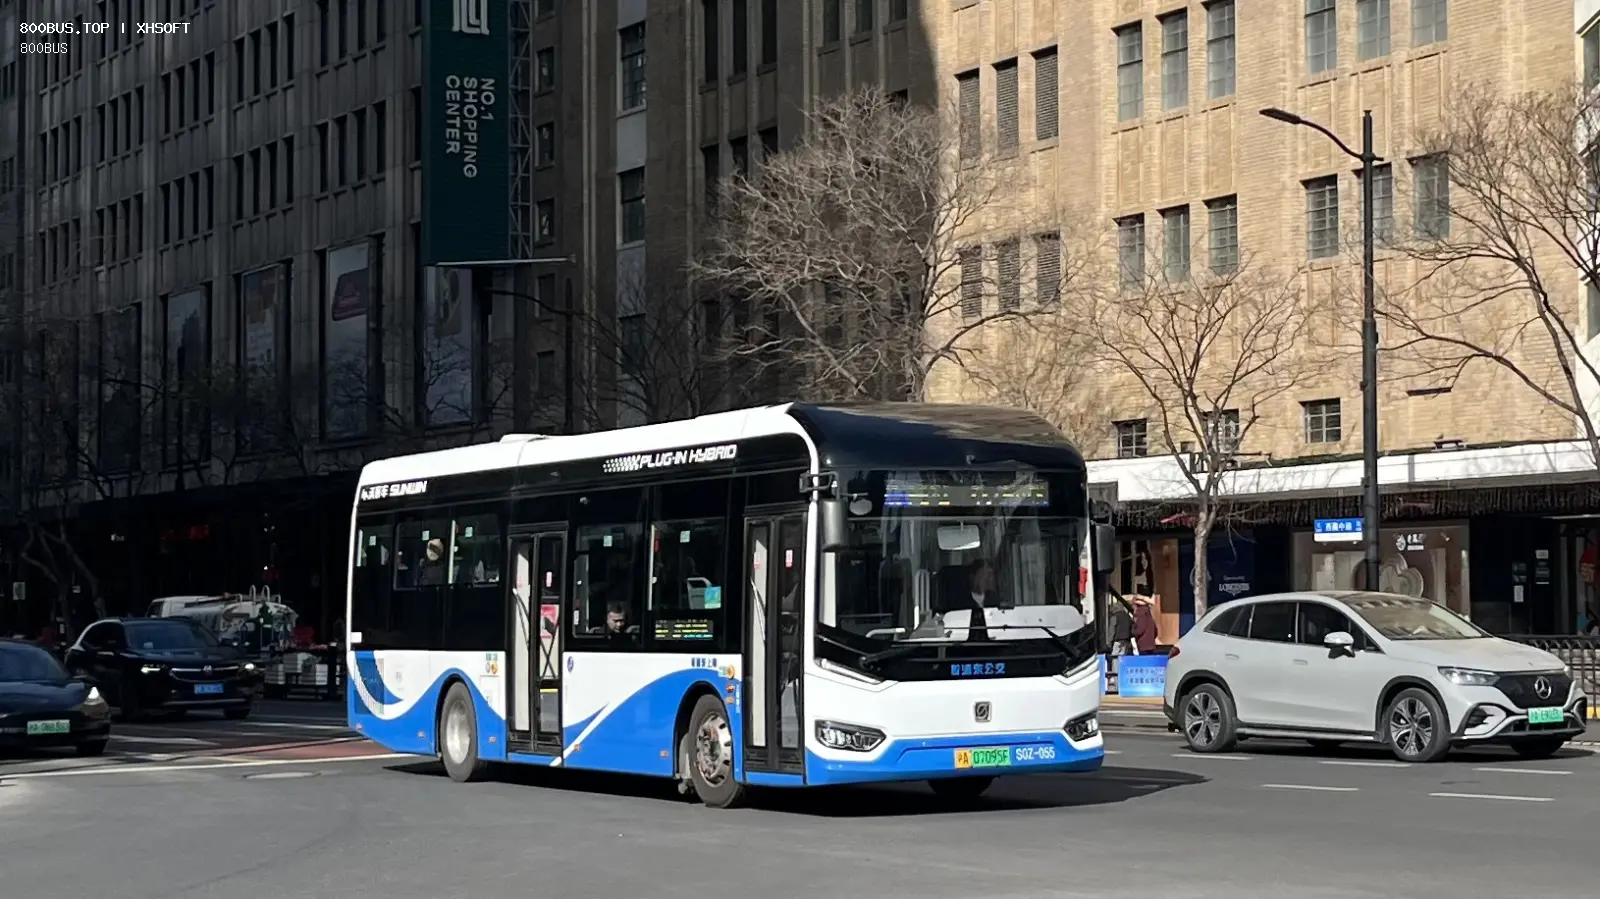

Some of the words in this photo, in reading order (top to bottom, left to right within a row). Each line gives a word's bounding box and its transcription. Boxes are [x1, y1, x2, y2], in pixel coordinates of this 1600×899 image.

[445, 75, 460, 154] CENTER
[463, 76, 478, 179] SHOPPING
[480, 78, 495, 121] NO.1
[639, 450, 687, 469] PLUG-IN
[688, 444, 737, 464] HYBRID
